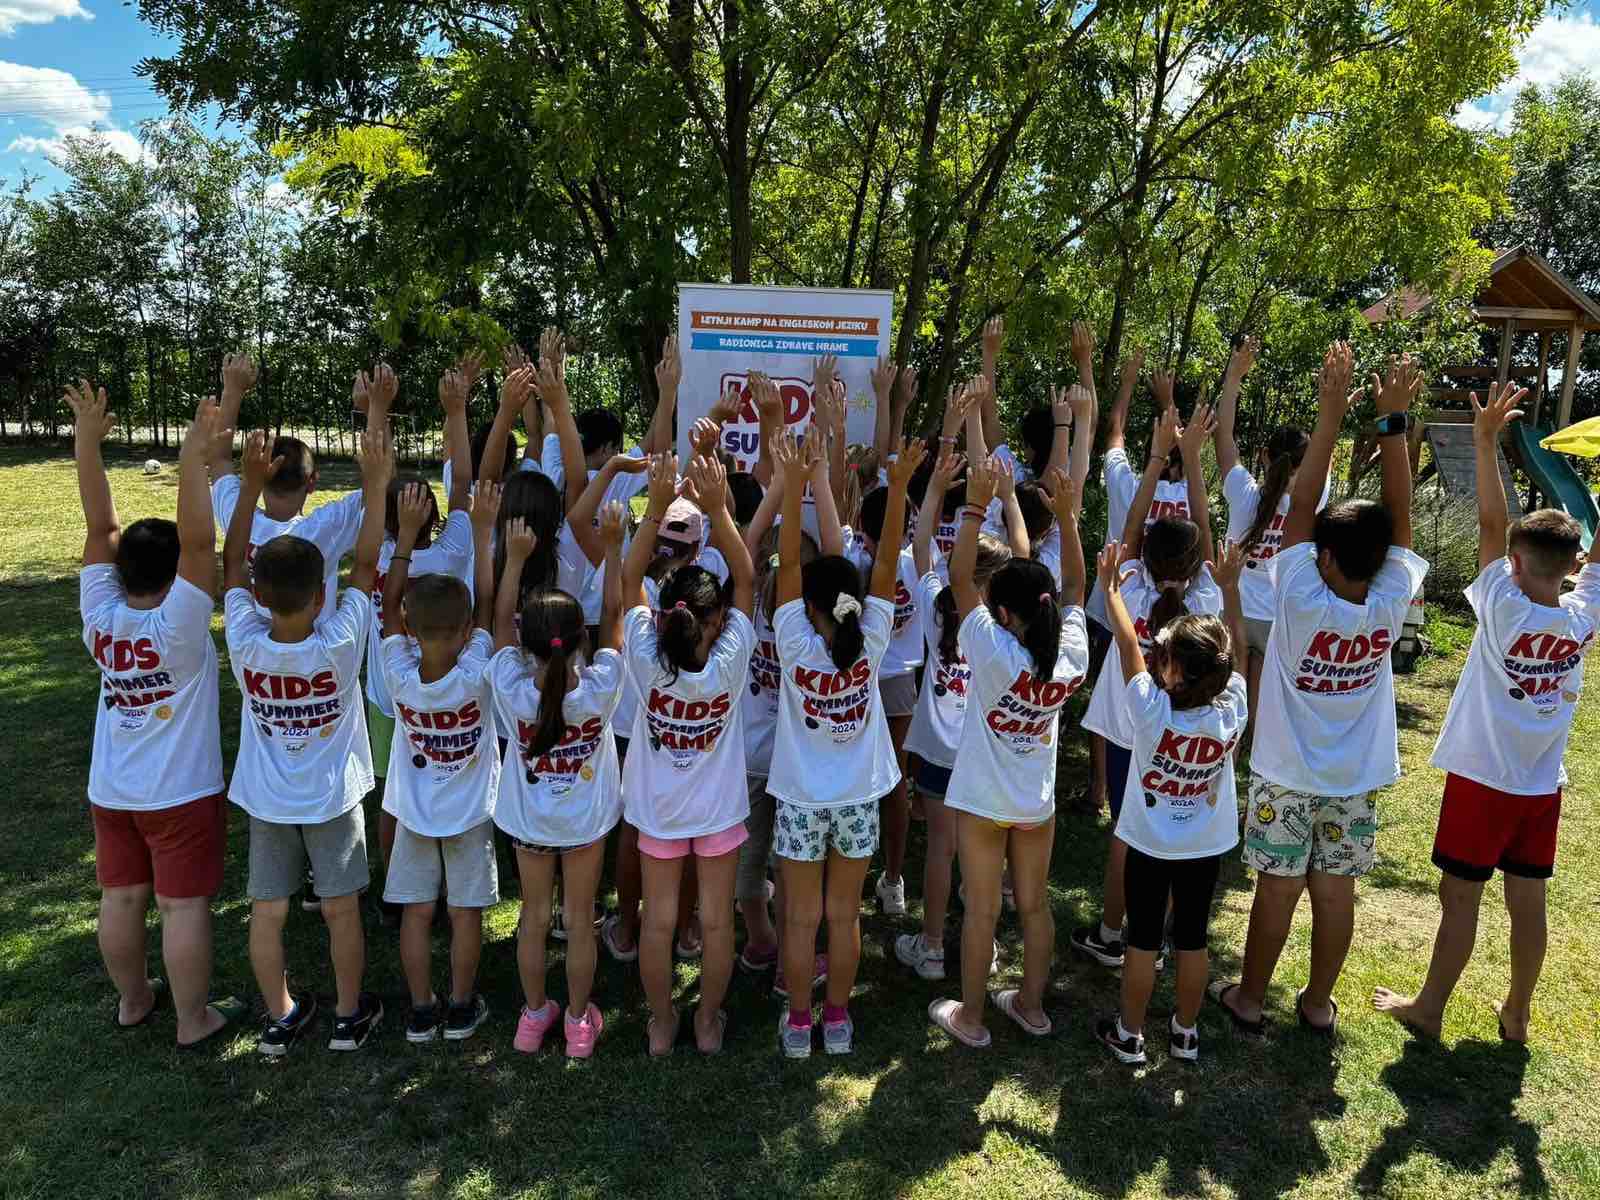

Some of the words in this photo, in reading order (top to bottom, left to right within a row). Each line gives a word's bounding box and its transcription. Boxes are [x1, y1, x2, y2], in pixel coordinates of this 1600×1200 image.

[701, 315, 732, 325] LETNJI
[733, 317, 761, 327] KAMP
[763, 318, 778, 328] NA
[779, 319, 834, 330] ENGLESKOM
[835, 321, 868, 331] JEZIKU
[719, 338, 773, 349] RADIONICA
[775, 340, 814, 351] ZDRAVE
[816, 342, 849, 352] HRANE
[1149, 501, 1187, 520] IDS
[94, 630, 160, 672] KDS
[1307, 628, 1391, 664] KIDS
[1507, 632, 1593, 661] KID
[104, 672, 172, 691] MMER
[243, 668, 337, 699] KIDS
[795, 658, 871, 696] KIDS
[251, 699, 341, 719] SUMMER
[647, 688, 730, 720] KIDS
[808, 683, 869, 709] MMER
[998, 694, 1050, 720] SUM
[396, 700, 480, 730] KIDS
[282, 727, 310, 737] 2024
[517, 718, 602, 745] KDS
[832, 724, 856, 734] 2024
[1152, 755, 1224, 780] SUMM
[1142, 770, 1209, 797] CAM
